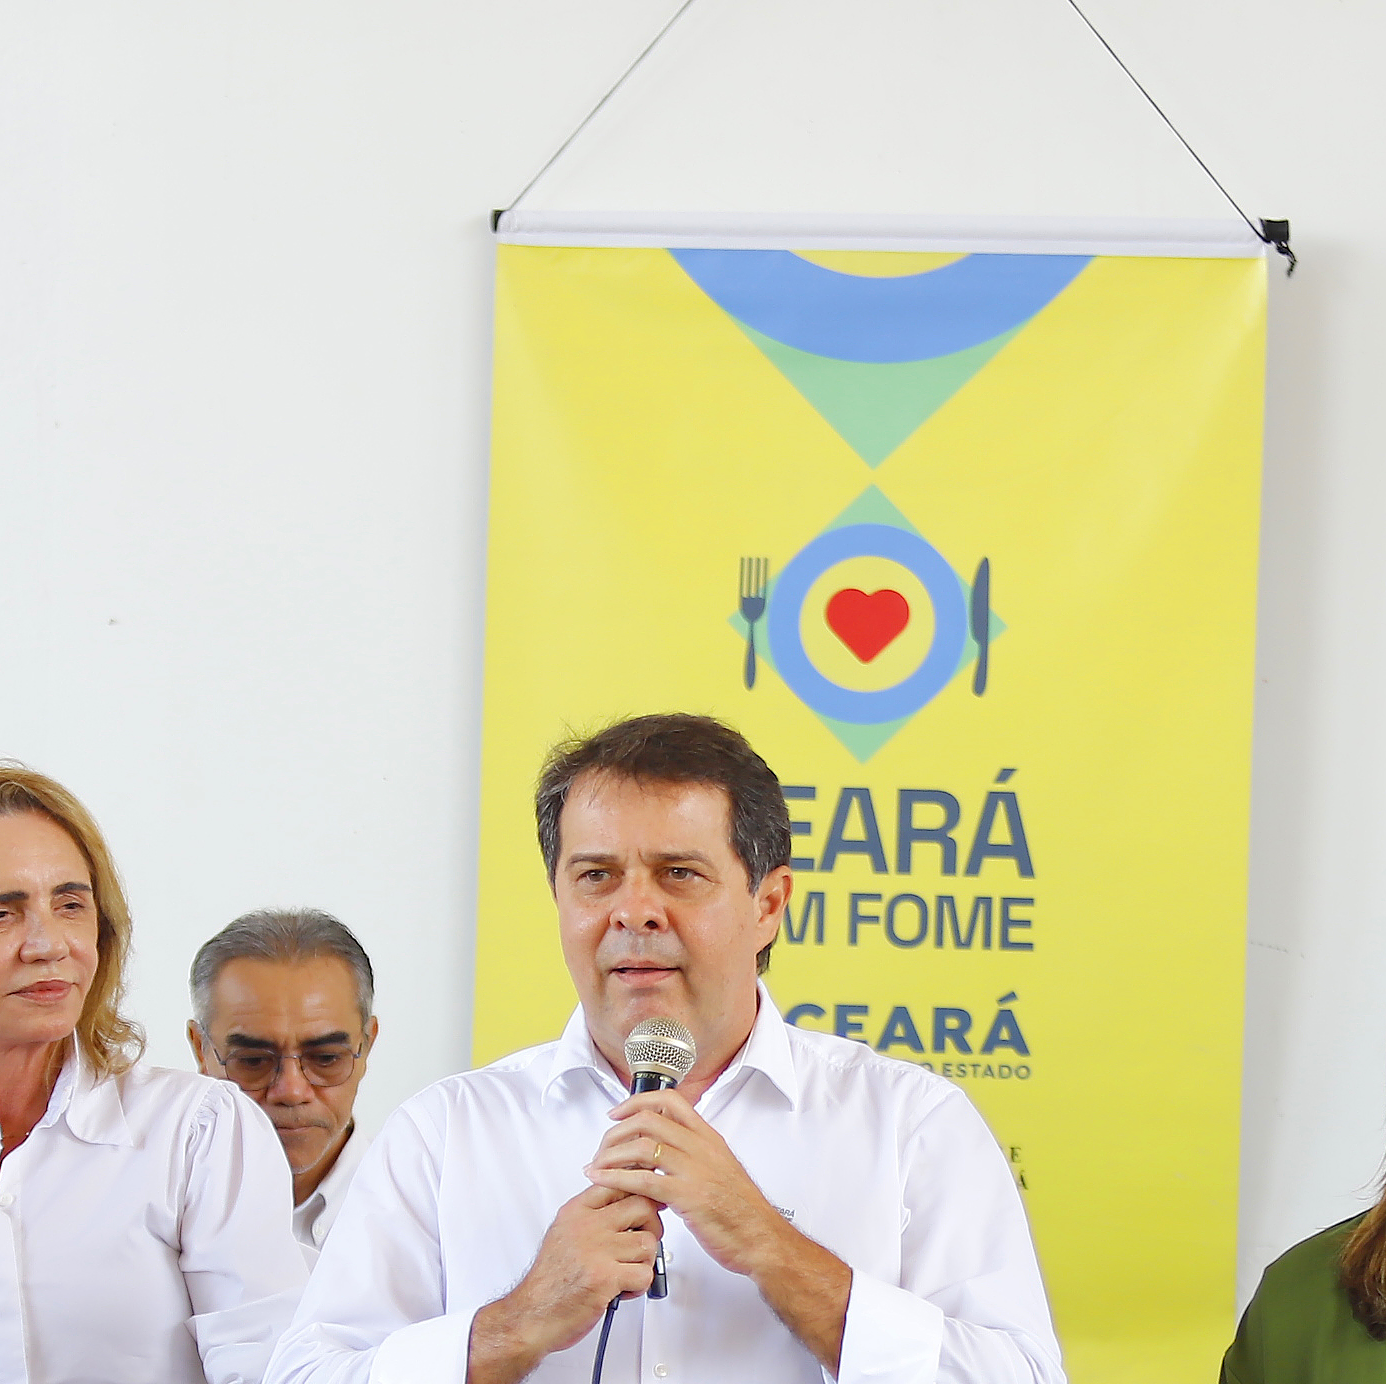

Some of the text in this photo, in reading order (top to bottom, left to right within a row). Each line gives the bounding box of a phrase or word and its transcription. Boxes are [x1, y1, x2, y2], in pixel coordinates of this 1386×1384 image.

[780, 768, 1035, 879] EARÁ
[847, 892, 1035, 951] FOME
[942, 1062, 1031, 1079] ESTADO
